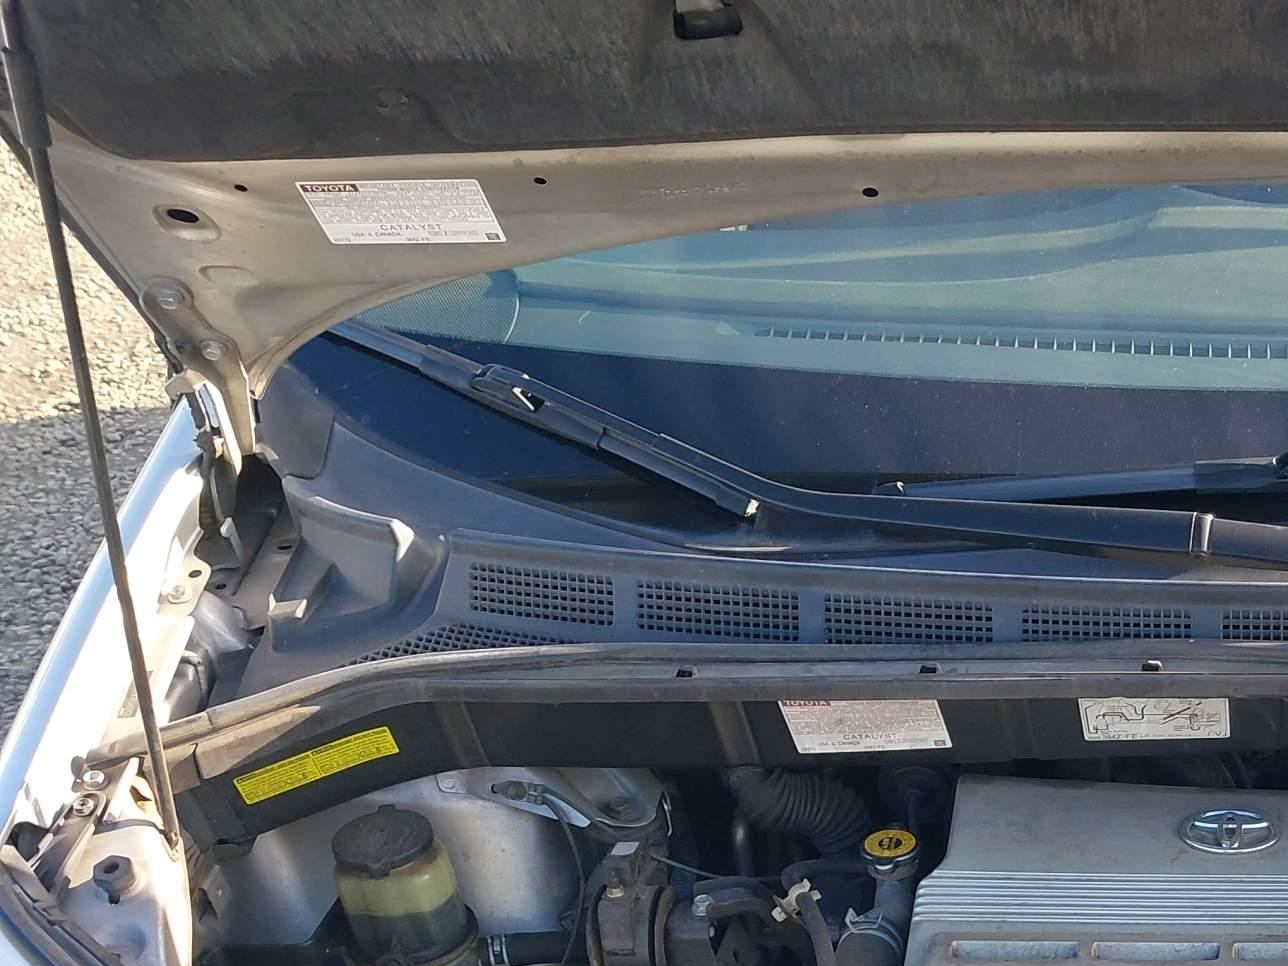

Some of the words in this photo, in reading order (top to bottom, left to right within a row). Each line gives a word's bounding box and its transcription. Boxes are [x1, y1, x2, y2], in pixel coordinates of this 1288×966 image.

[304, 184, 355, 193] TOYOTA
[379, 223, 442, 232] CATALYST
[842, 732, 897, 741] CATALYST
